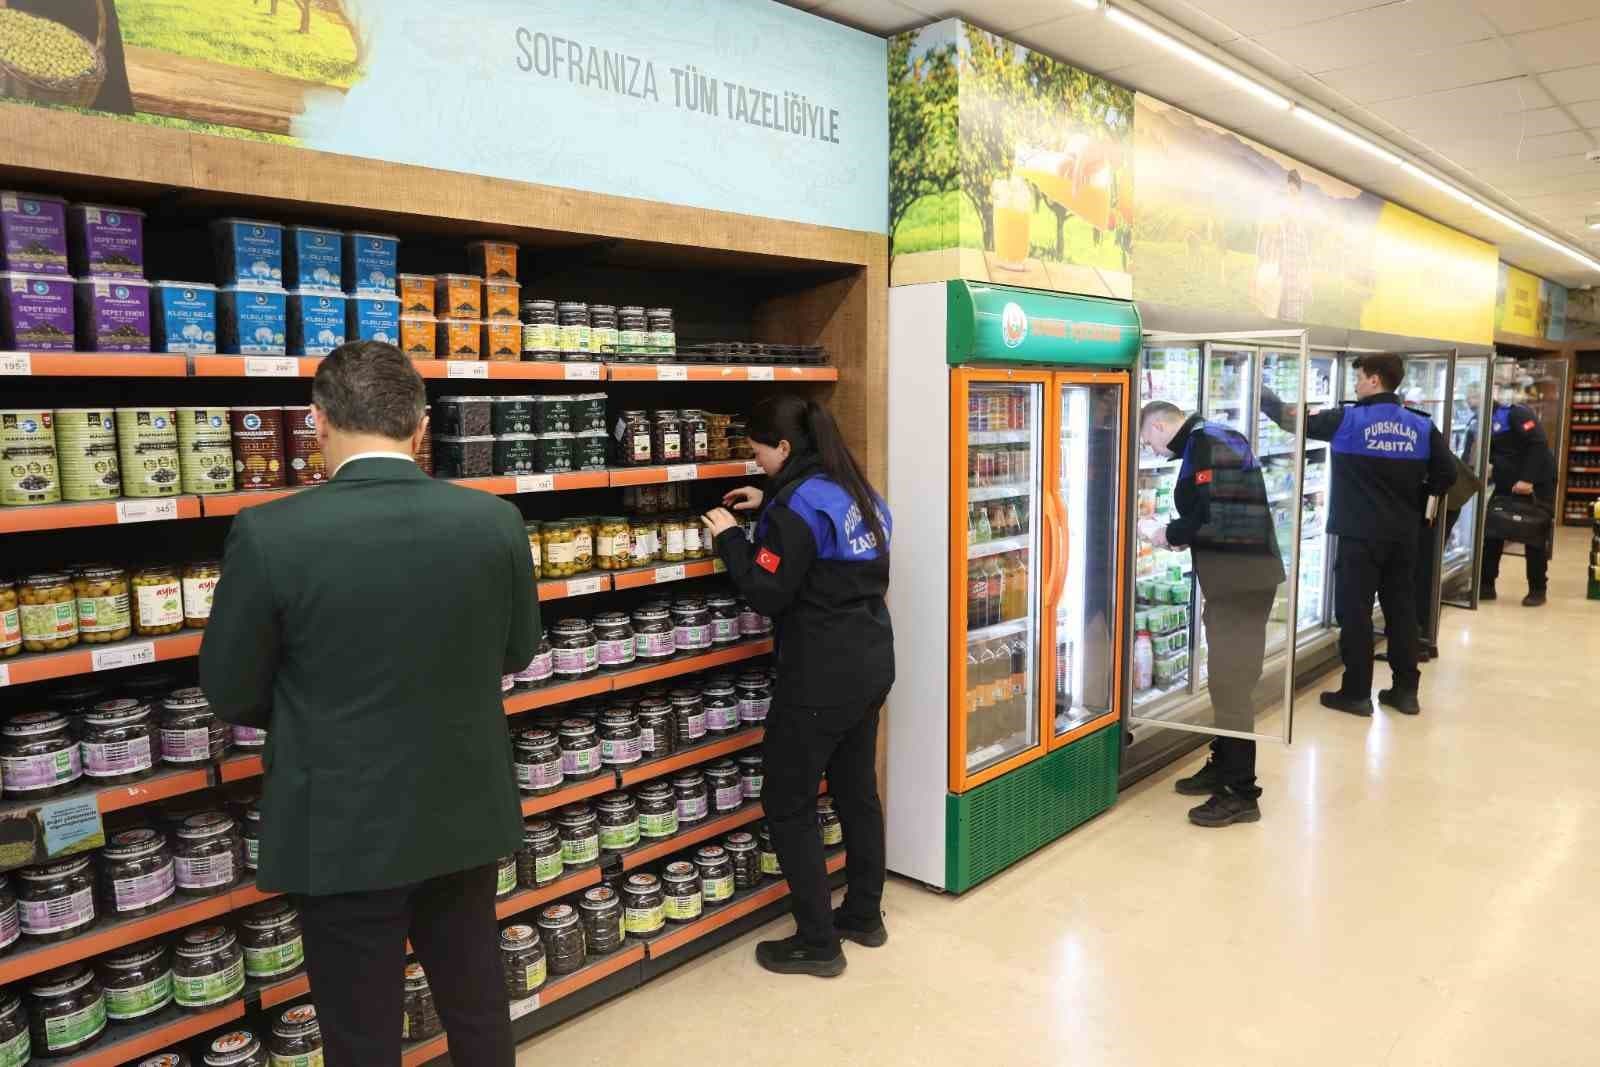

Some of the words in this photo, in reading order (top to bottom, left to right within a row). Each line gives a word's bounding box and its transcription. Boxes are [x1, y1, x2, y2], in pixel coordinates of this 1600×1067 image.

[515, 27, 659, 103] SOFRANIZA
[670, 64, 718, 117] TÜM
[723, 81, 840, 144] TAZELİĞİYLE
[1366, 439, 1414, 453] ZABITA
[849, 531, 877, 555] ZAB
